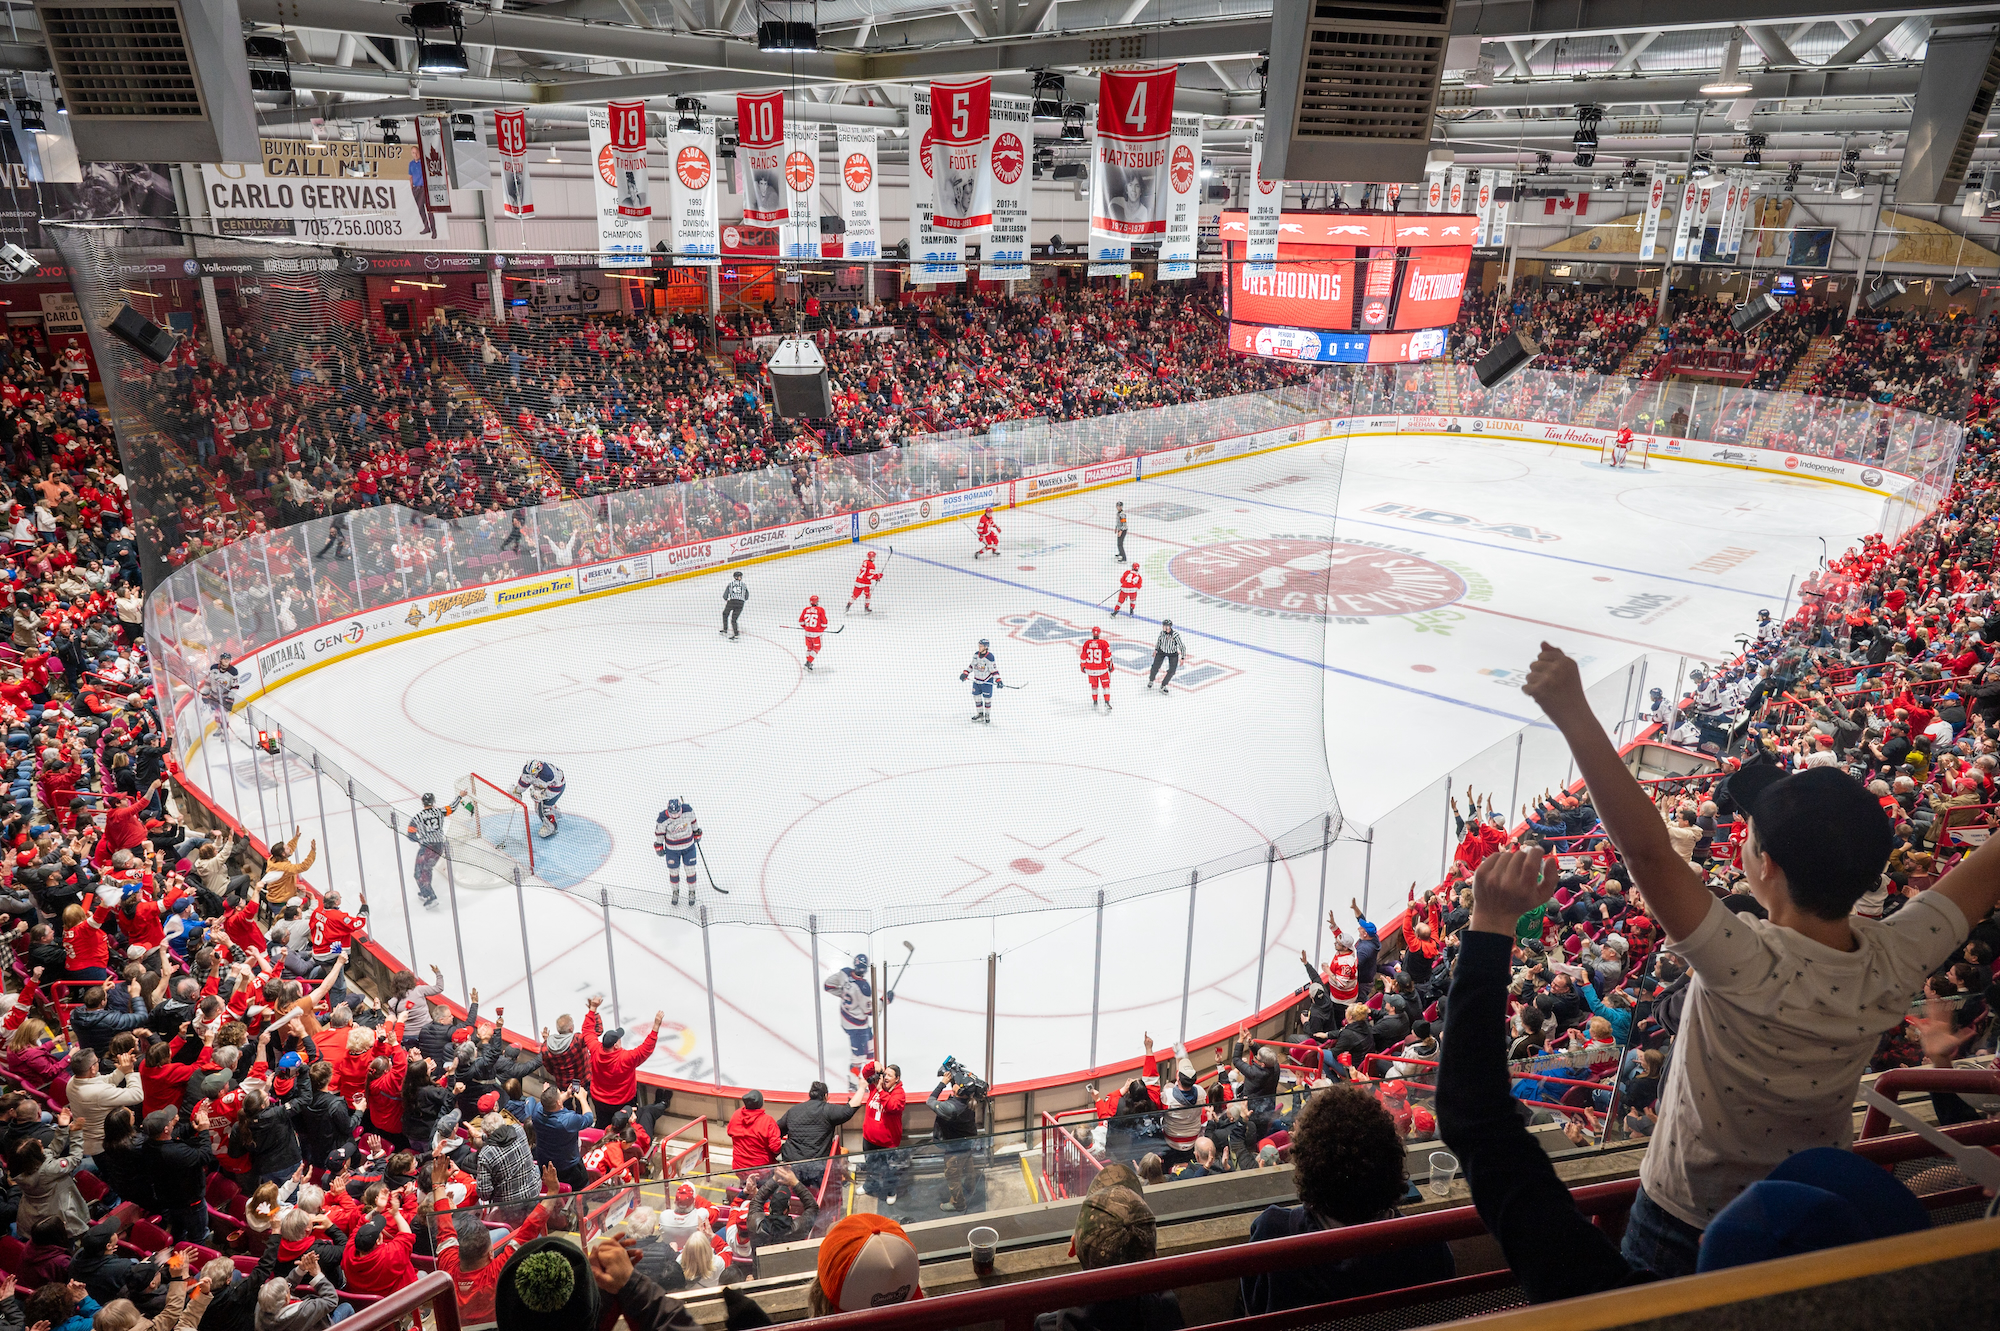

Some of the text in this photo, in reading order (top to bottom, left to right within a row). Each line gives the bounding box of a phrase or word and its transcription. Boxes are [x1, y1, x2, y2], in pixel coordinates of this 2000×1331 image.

[914, 92, 931, 102] SAULT
[1014, 102, 1030, 110] MARIE
[1125, 82, 1148, 132] 4
[952, 92, 970, 138] 5
[990, 110, 1029, 122] GREYHOUNDS
[618, 110, 639, 146] 19
[749, 102, 774, 142] 10
[501, 118, 523, 150] 99
[838, 134, 876, 142] GREYHOUNDS
[1002, 136, 1016, 146] SOO
[265, 142, 316, 156] BUYING
[343, 144, 402, 159] SELLING?
[686, 148, 699, 158] SOO
[1125, 144, 1142, 152] CRAIG
[1178, 146, 1188, 158] SOO
[792, 154, 804, 162] SOO
[852, 155, 864, 164] SOO
[950, 154, 976, 170] FOOTE
[1100, 148, 1164, 168] HARTSBURG
[268, 158, 330, 177] CALL
[992, 162, 1022, 183] GREYHOUNDS
[679, 170, 710, 189] GREYHOUNDS
[1172, 173, 1194, 194] GREYHOUNDS
[212, 184, 396, 210] CARLO GERVASI
[615, 220, 628, 228] CUP
[682, 220, 710, 228] DIVISION
[1174, 214, 1186, 222] WEST
[222, 220, 276, 230] CENTURY
[302, 220, 402, 236] 705.256.0083
[678, 230, 715, 238] CHAMPIONS
[742, 230, 780, 246] LEGEN
[846, 228, 874, 236] CHAMPIONS
[921, 236, 958, 244] CHAMPIONS
[991, 235, 1024, 243] CHAMPIONS
[1167, 234, 1190, 244] CHAMPIONS
[1250, 238, 1274, 246] CHAMPIONS
[202, 264, 252, 273] Volkswagen
[372, 259, 411, 268] TOYOTA
[508, 258, 545, 266] Volkswagen
[36, 266, 78, 277] OYOTA
[1242, 265, 1342, 301] GREYHOUNDS
[1409, 267, 1464, 302] GREYHOUNDS
[240, 286, 260, 294] 106
[46, 312, 78, 322] CARLO
[1246, 336, 1252, 348] 2
[1329, 343, 1338, 356] 0
[1401, 344, 1406, 356] 2
[1544, 426, 1603, 445] Tim Hortons
[1086, 464, 1132, 482] PHARMASAVE
[1800, 460, 1845, 475] Independent
[1038, 477, 1064, 488] MAVERICK
[944, 494, 962, 505] ROSS
[964, 490, 993, 501] ROMANO
[805, 524, 834, 534] Compass
[740, 530, 784, 547] CARSTAR
[1270, 532, 1426, 558] MEMORIAL
[668, 544, 712, 564] CHUCK'S
[588, 568, 612, 578] IBEW
[498, 581, 572, 602] Fountain Tire
[1280, 558, 1451, 614] GREYHOUNDS
[804, 614, 818, 627] 26
[314, 632, 342, 652] GEN
[366, 620, 392, 632] FUEL
[260, 641, 306, 678] MONTANA'S
[1086, 648, 1102, 664] 39
[314, 924, 325, 946] 6
[1525, 1059, 1572, 1074] STANDING
